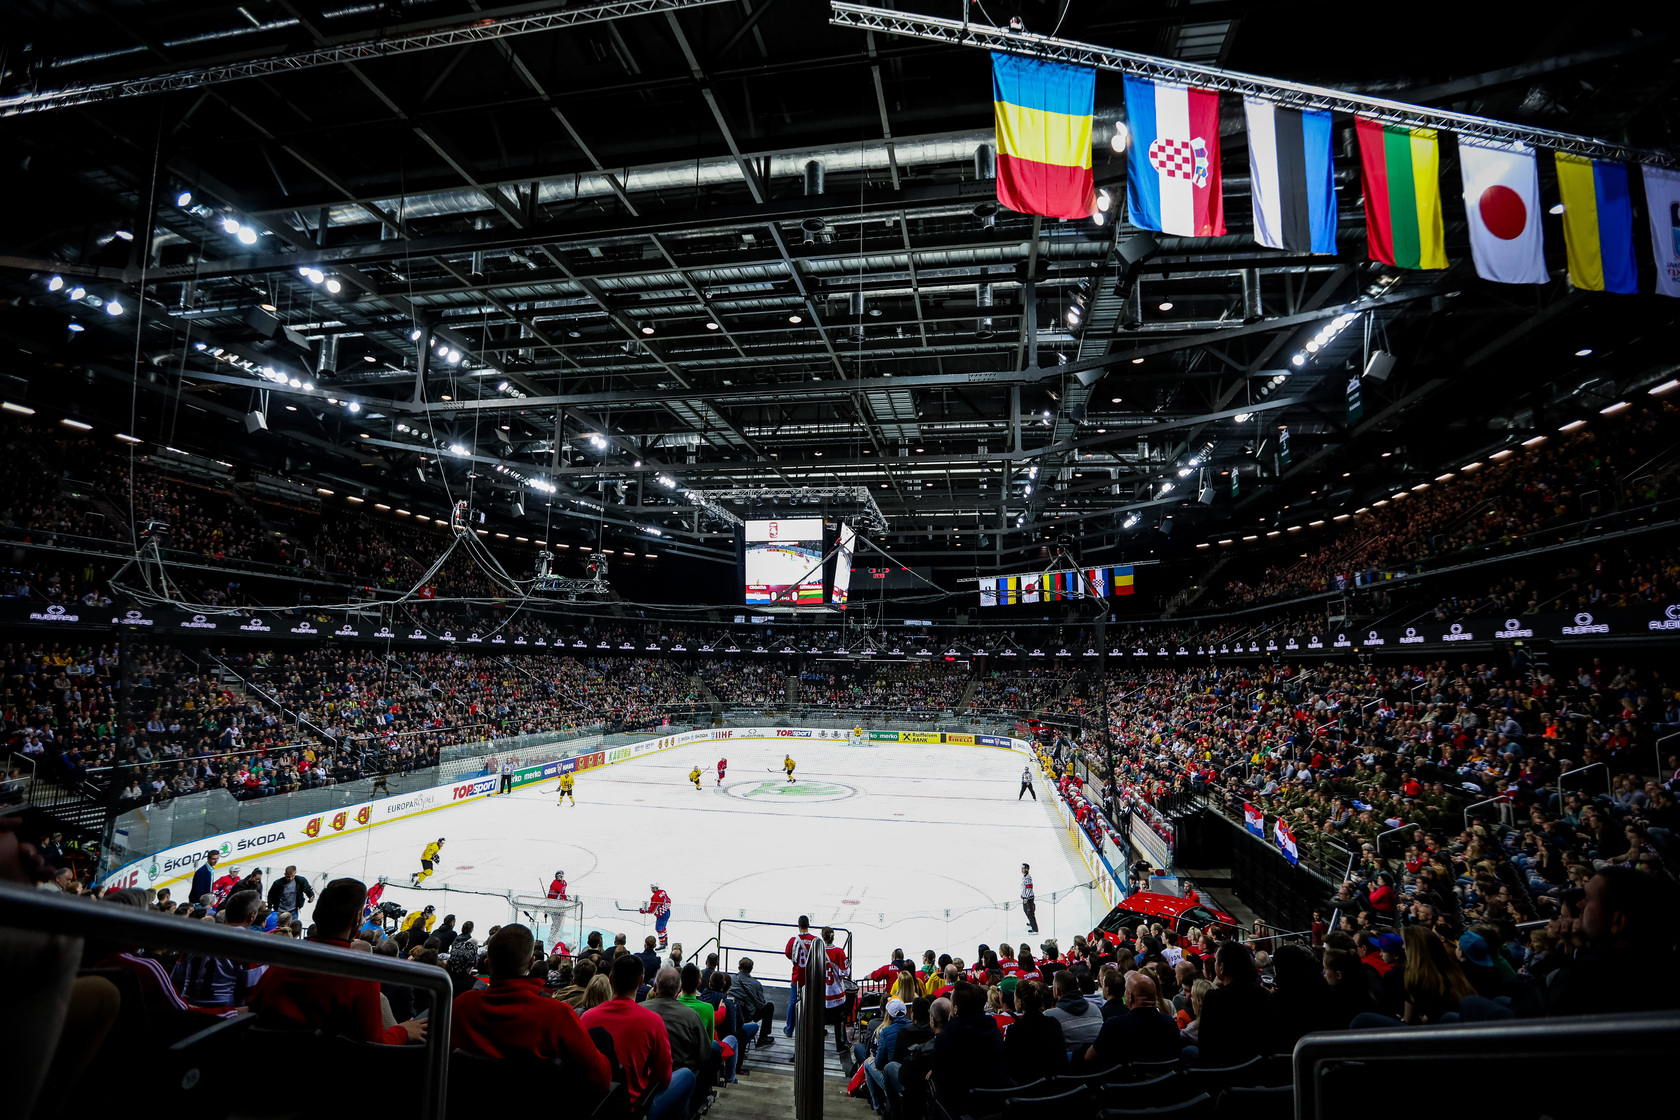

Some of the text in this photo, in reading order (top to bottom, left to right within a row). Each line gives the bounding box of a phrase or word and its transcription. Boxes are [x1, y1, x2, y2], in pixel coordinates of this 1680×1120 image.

[30, 613, 79, 622] AUDIMAS
[1562, 624, 1610, 635] AUDIMAS
[1648, 620, 1680, 630] AUDI
[715, 730, 733, 739] IIHF
[524, 770, 541, 780] merko
[237, 832, 285, 851] ŠKODA
[164, 850, 210, 872] ŠKODA
